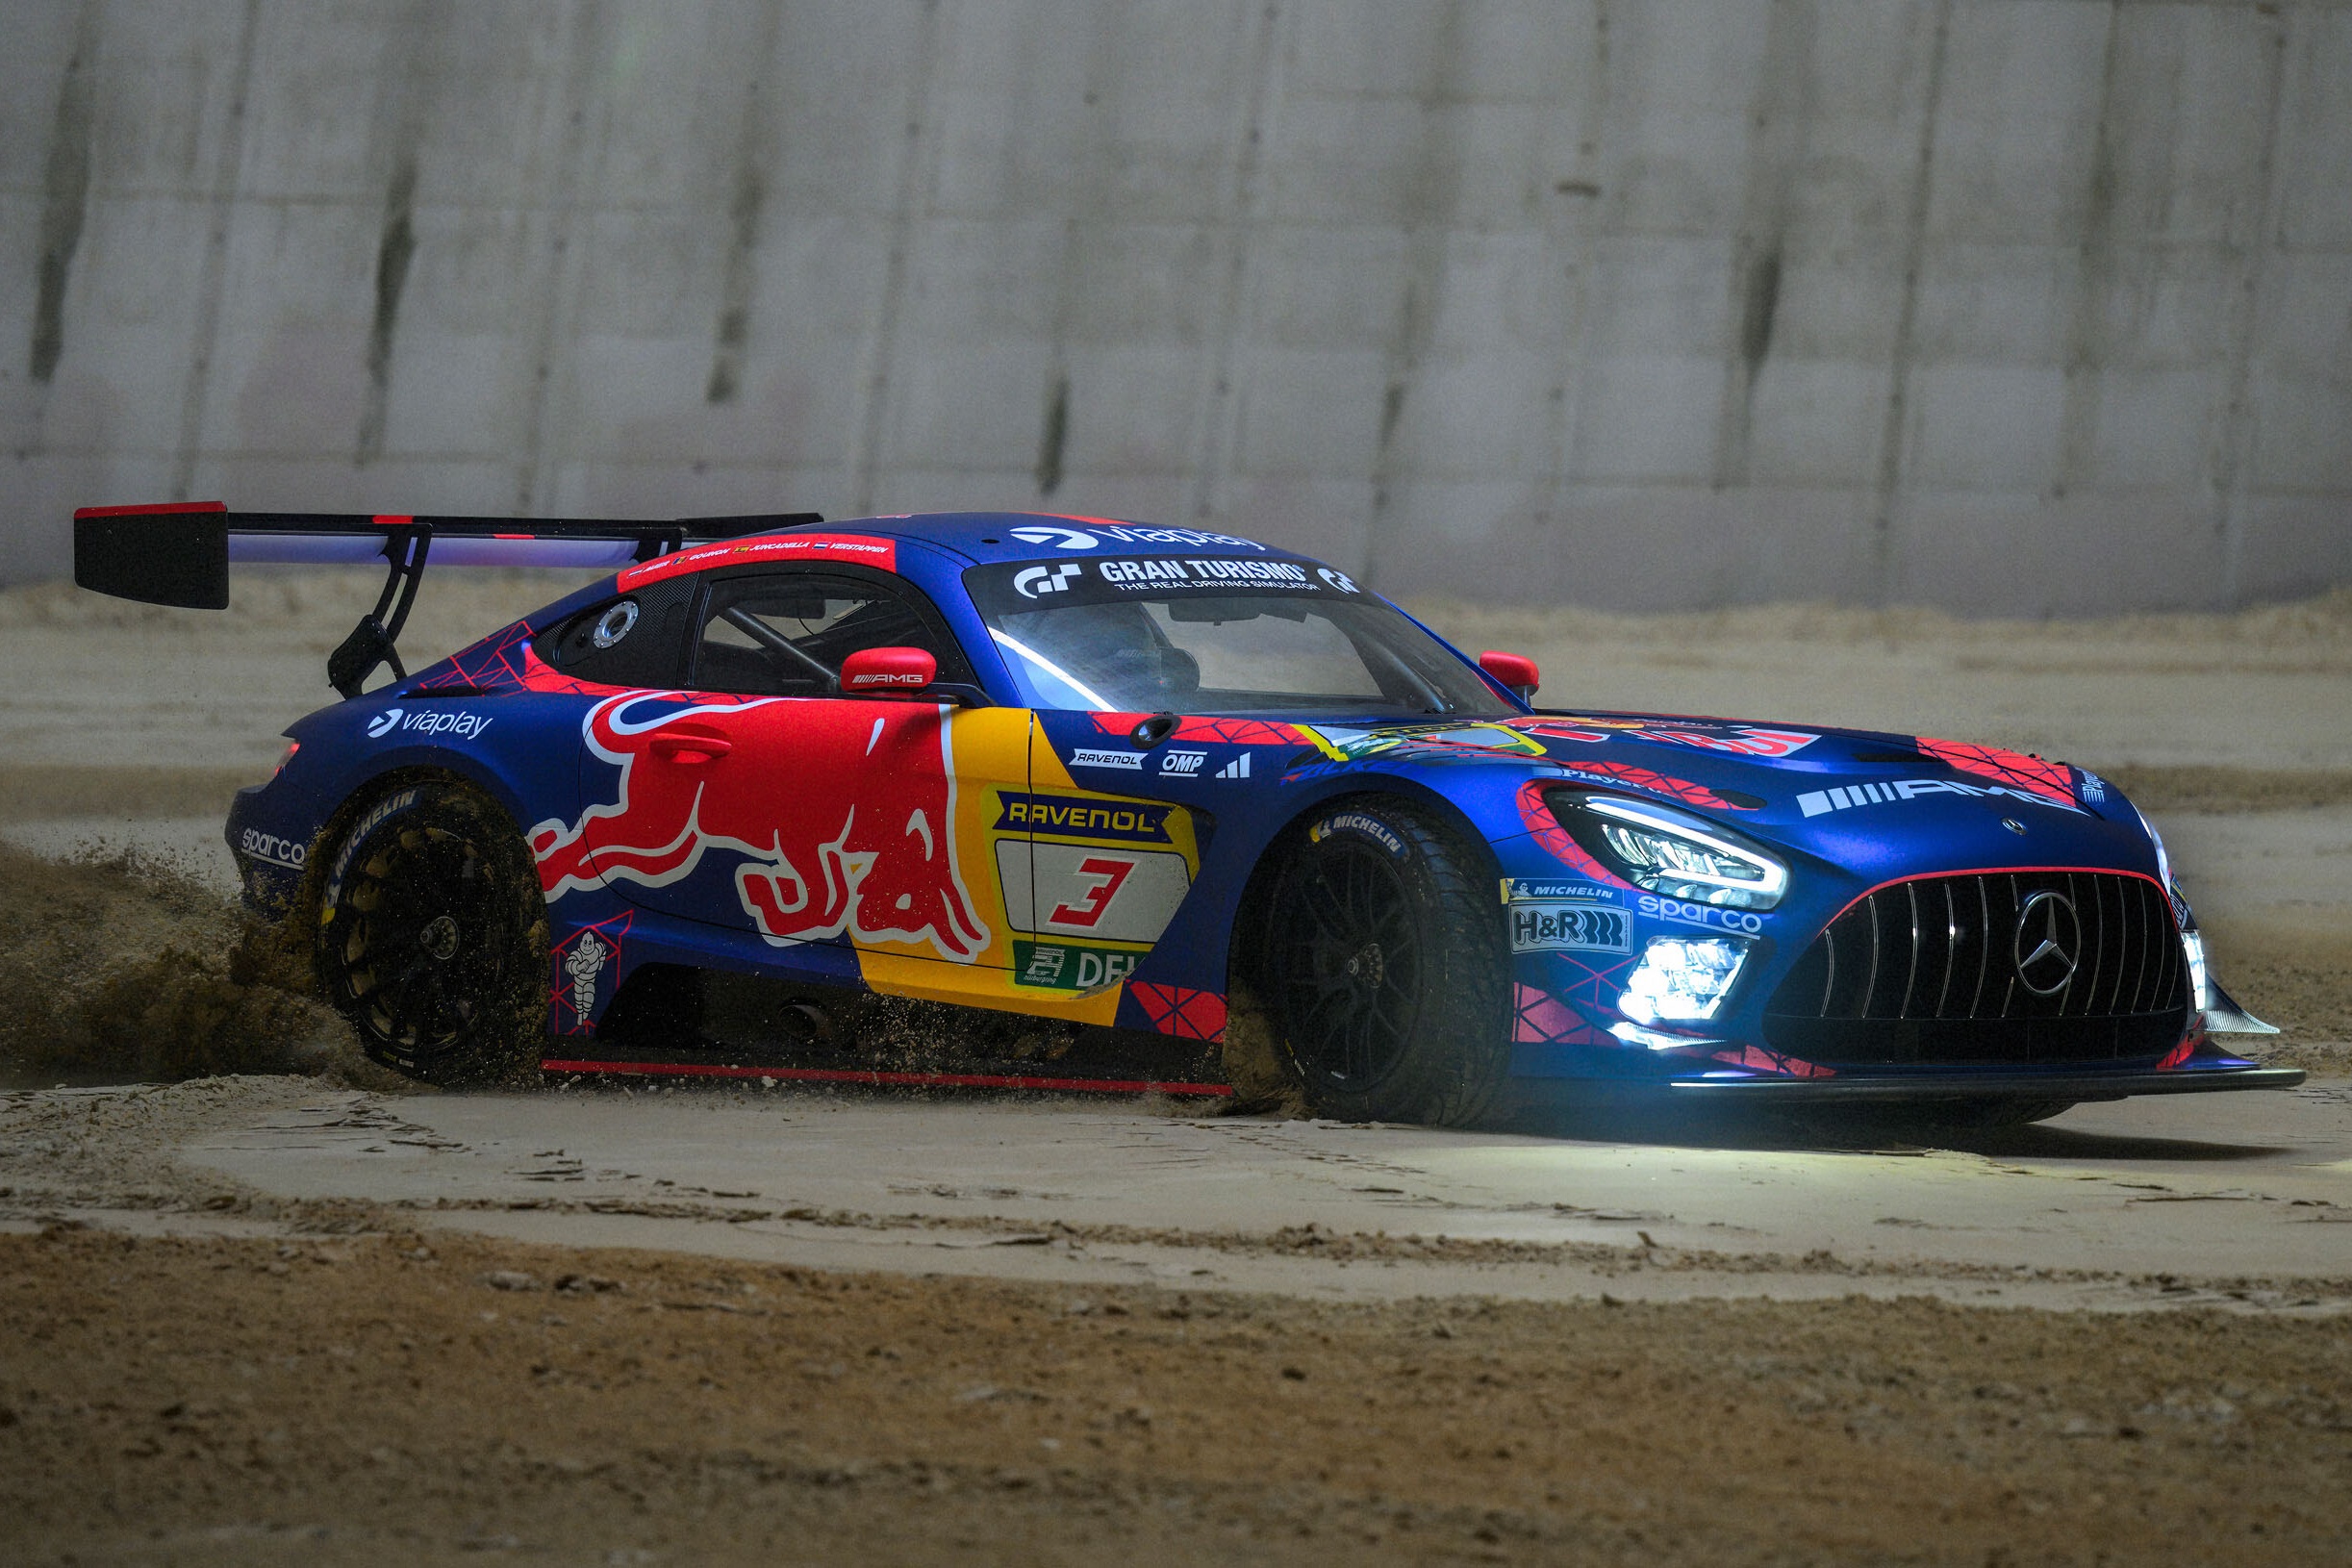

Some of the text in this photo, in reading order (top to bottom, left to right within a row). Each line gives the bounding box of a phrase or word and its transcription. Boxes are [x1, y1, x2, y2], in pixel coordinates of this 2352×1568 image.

[830, 543, 888, 553] VERSTAPPEN
[1086, 525, 1266, 551] viaplay
[1099, 560, 1190, 582] GRAN
[1114, 580, 1322, 592] THE REAL DRIVING SIMULATOR
[872, 674, 923, 684] AMG
[403, 710, 493, 741] viaplay
[1076, 753, 1138, 765] RAVENOL
[1162, 754, 1204, 772] OMP
[1562, 769, 1645, 788] Player
[1008, 802, 1155, 833] RAVENOL
[241, 827, 306, 864] sparco
[1332, 815, 1403, 854] MICHELIN
[1049, 857, 1135, 927] 3
[1533, 886, 1614, 899] MICHELIN
[1638, 896, 1762, 932] sparco
[1513, 910, 1586, 946] H&R
